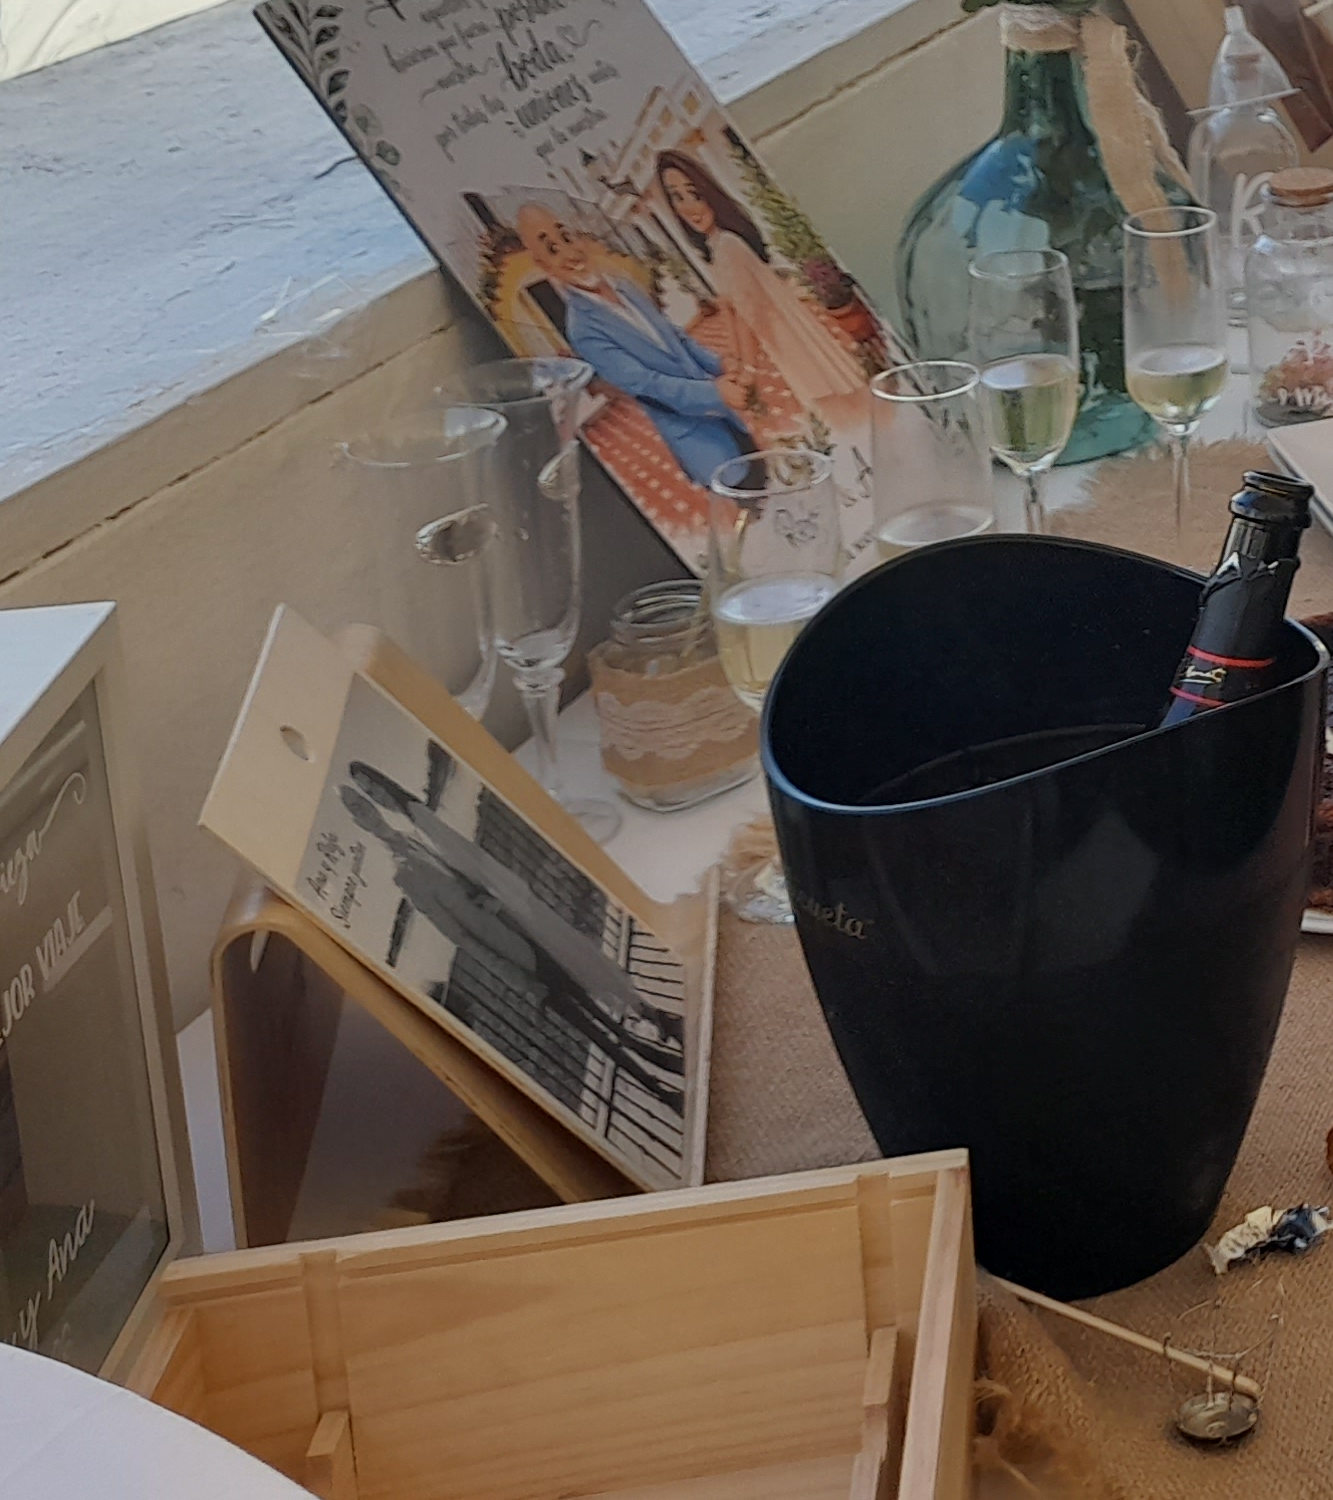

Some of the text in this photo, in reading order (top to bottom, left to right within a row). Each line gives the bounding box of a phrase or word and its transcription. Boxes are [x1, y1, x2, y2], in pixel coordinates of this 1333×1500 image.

[0, 890, 87, 1050] JOR VIAJE
[47, 1199, 96, 1301] Ana
